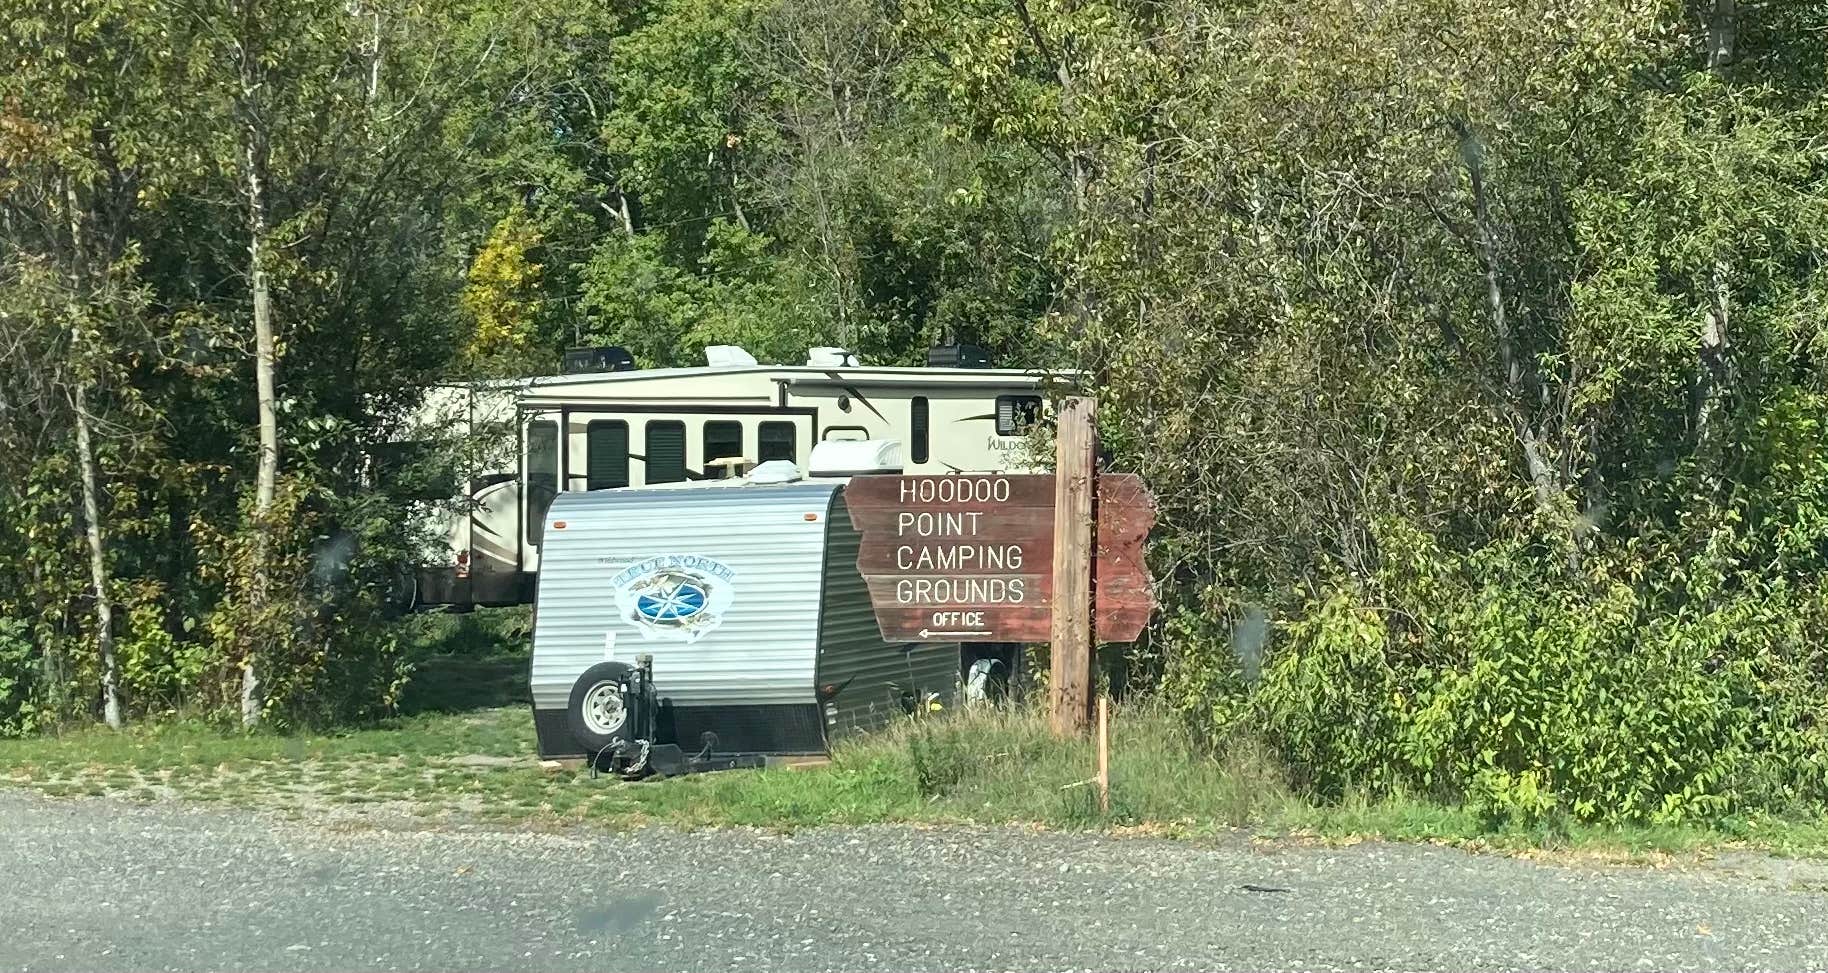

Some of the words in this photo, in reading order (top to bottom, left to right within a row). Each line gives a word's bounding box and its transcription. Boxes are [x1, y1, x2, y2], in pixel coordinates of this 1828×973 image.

[900, 478, 1010, 503] HOODOO
[898, 512, 983, 537] POINT
[897, 545, 1022, 570] CAMPING
[613, 556, 666, 588] TRUE
[670, 555, 736, 584] NORTH
[897, 579, 1024, 604] GROUNDS
[932, 611, 985, 627] OFFICE
